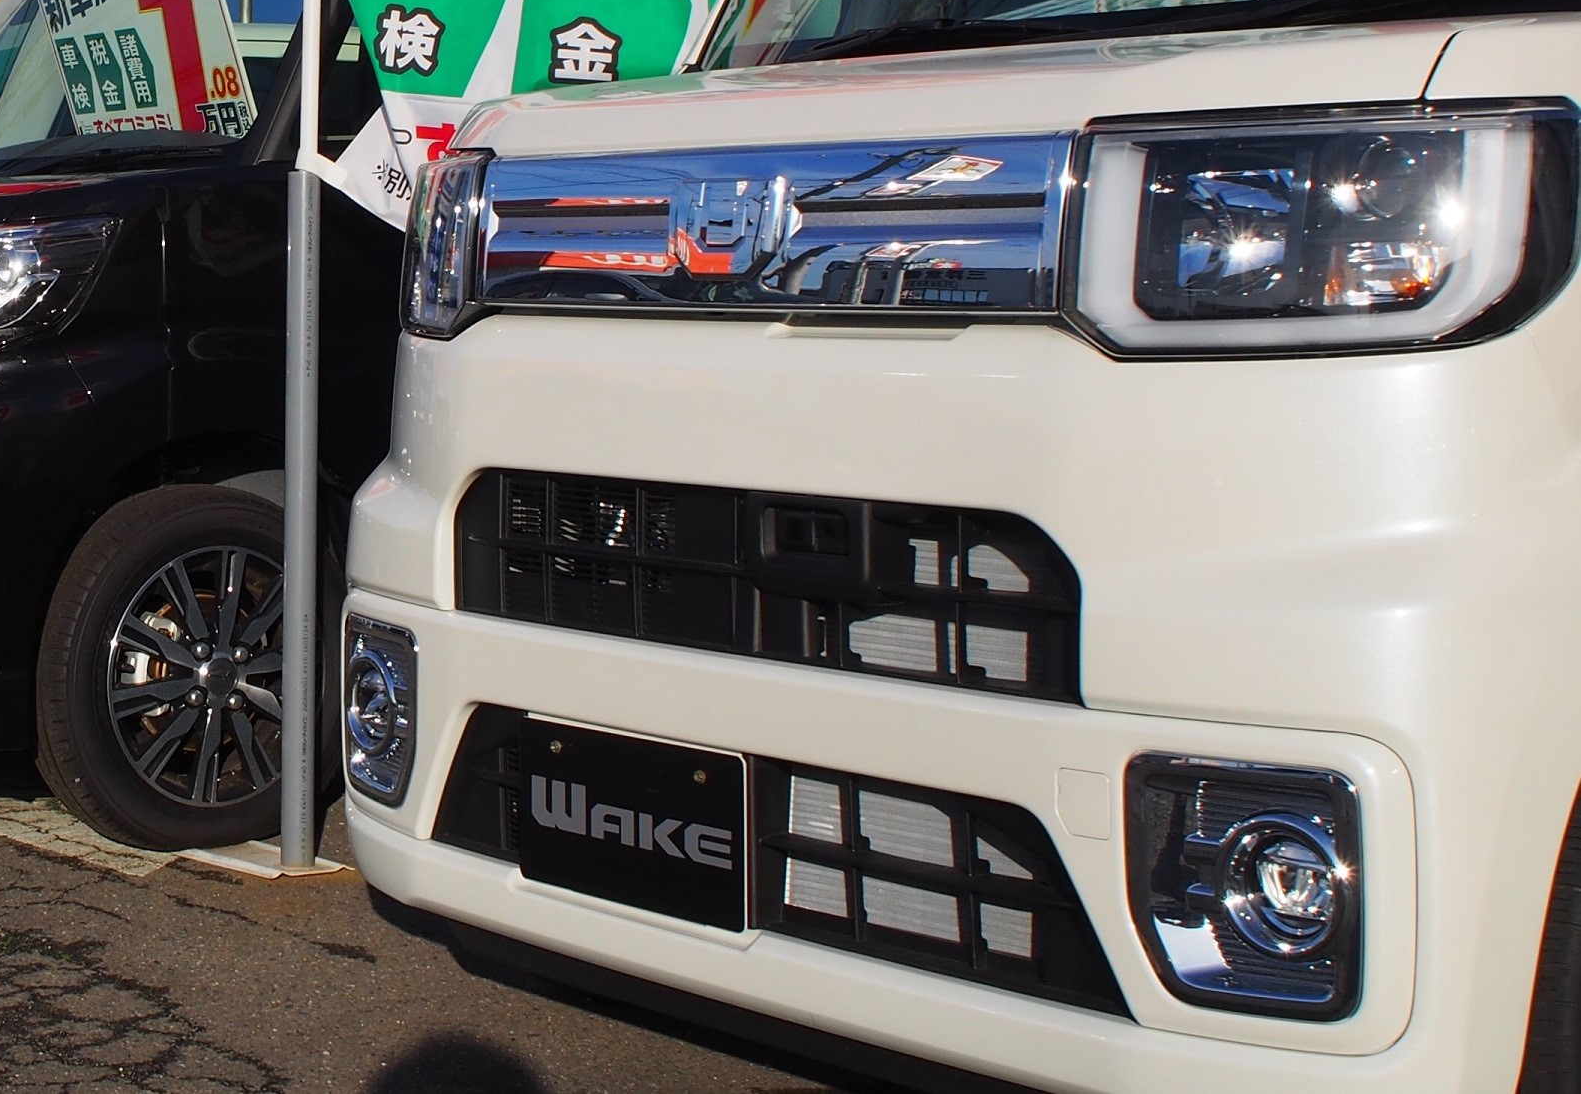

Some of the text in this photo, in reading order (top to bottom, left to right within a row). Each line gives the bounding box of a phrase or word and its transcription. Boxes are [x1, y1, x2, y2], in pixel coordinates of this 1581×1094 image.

[59, 43, 93, 109] 車検
[88, 39, 121, 106] 税金
[118, 34, 153, 103] 諸費用
[210, 65, 241, 100] .08
[530, 774, 734, 870] WAKE
